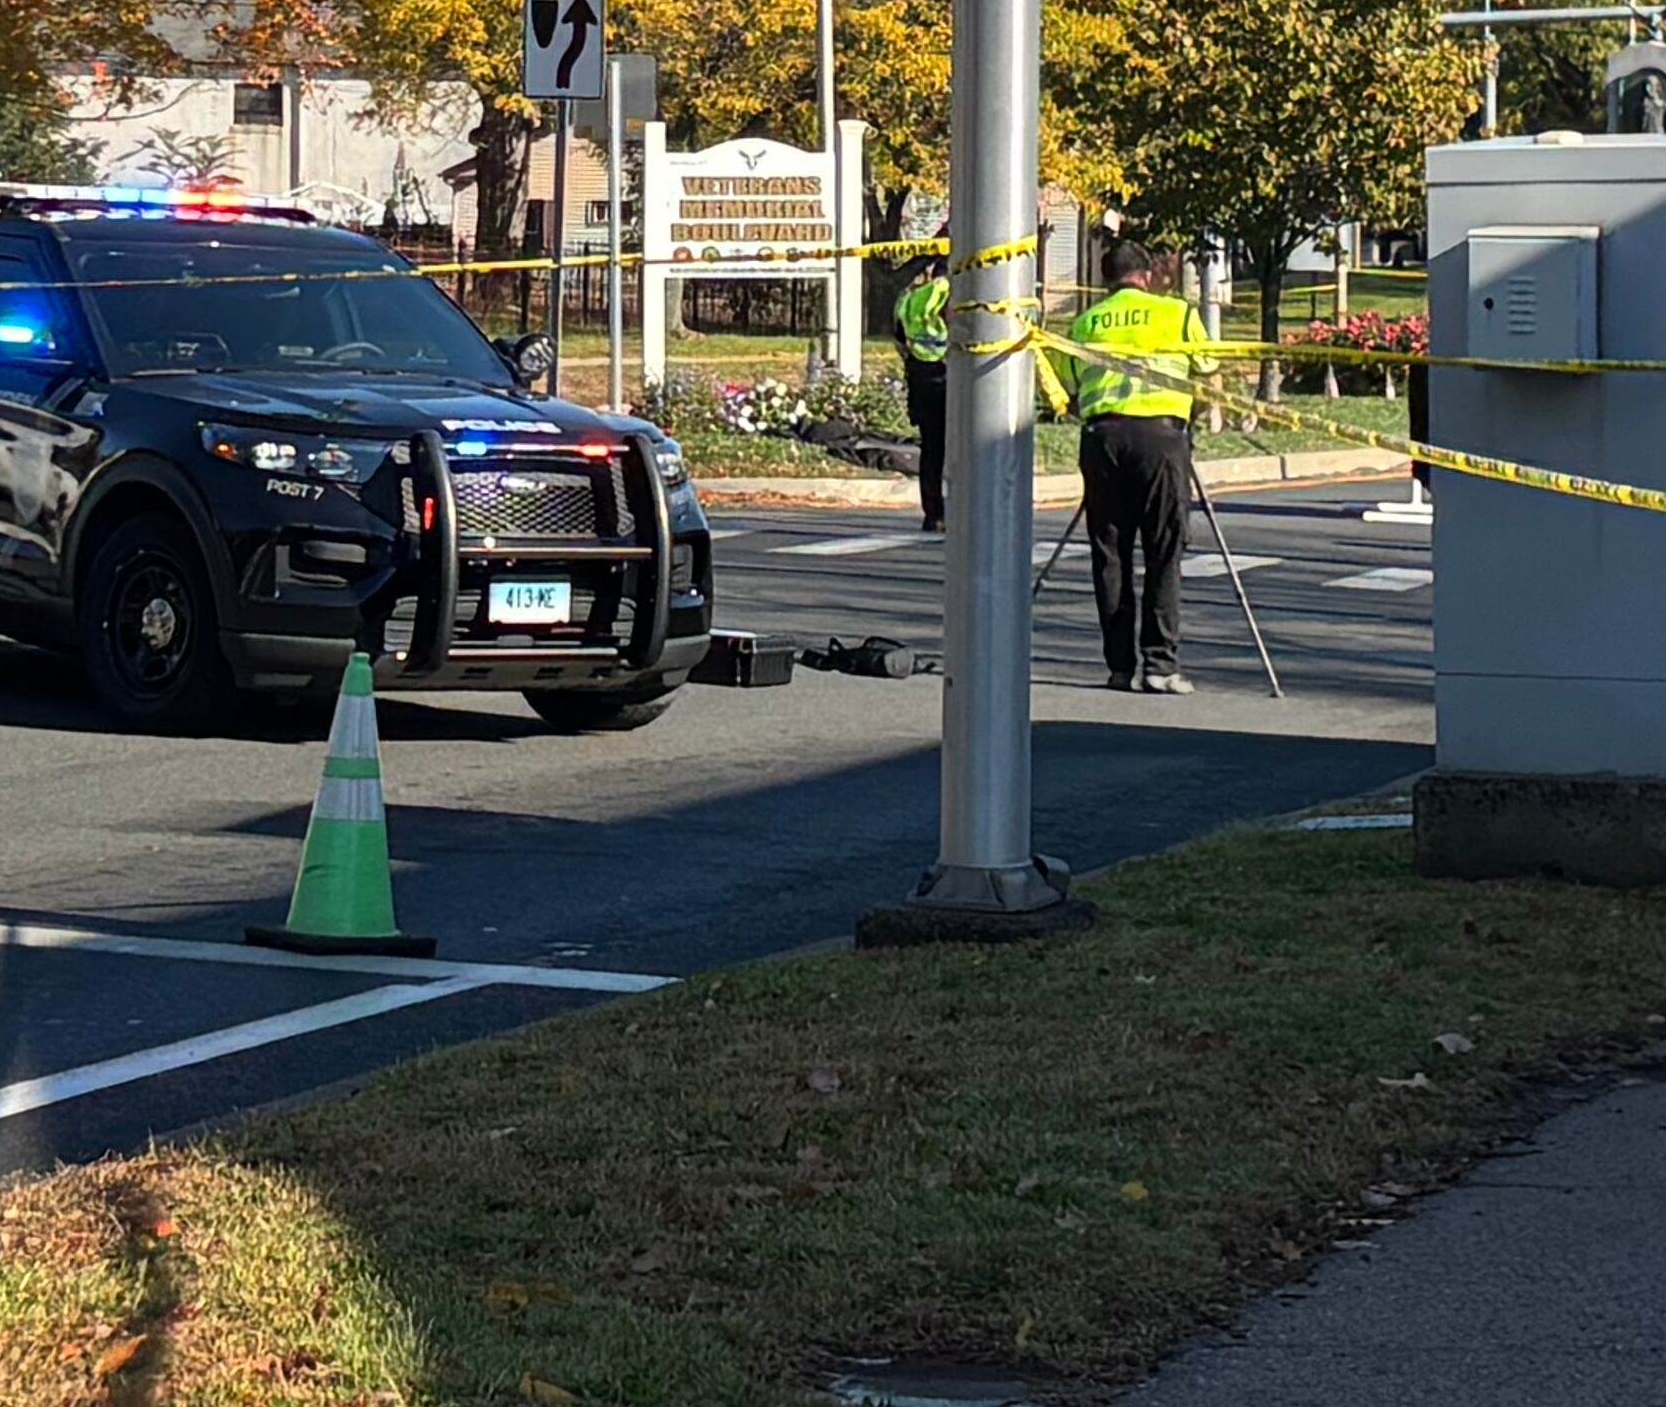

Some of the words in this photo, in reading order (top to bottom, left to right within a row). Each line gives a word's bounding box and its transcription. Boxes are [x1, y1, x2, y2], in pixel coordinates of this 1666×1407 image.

[681, 176, 822, 195] VETERANS
[679, 199, 826, 219] MEMORIAL
[671, 223, 833, 242] BOULEVARD
[1091, 309, 1149, 331] POLICE
[441, 419, 563, 433] POLICE
[266, 478, 311, 498] POST
[314, 486, 325, 500] 7
